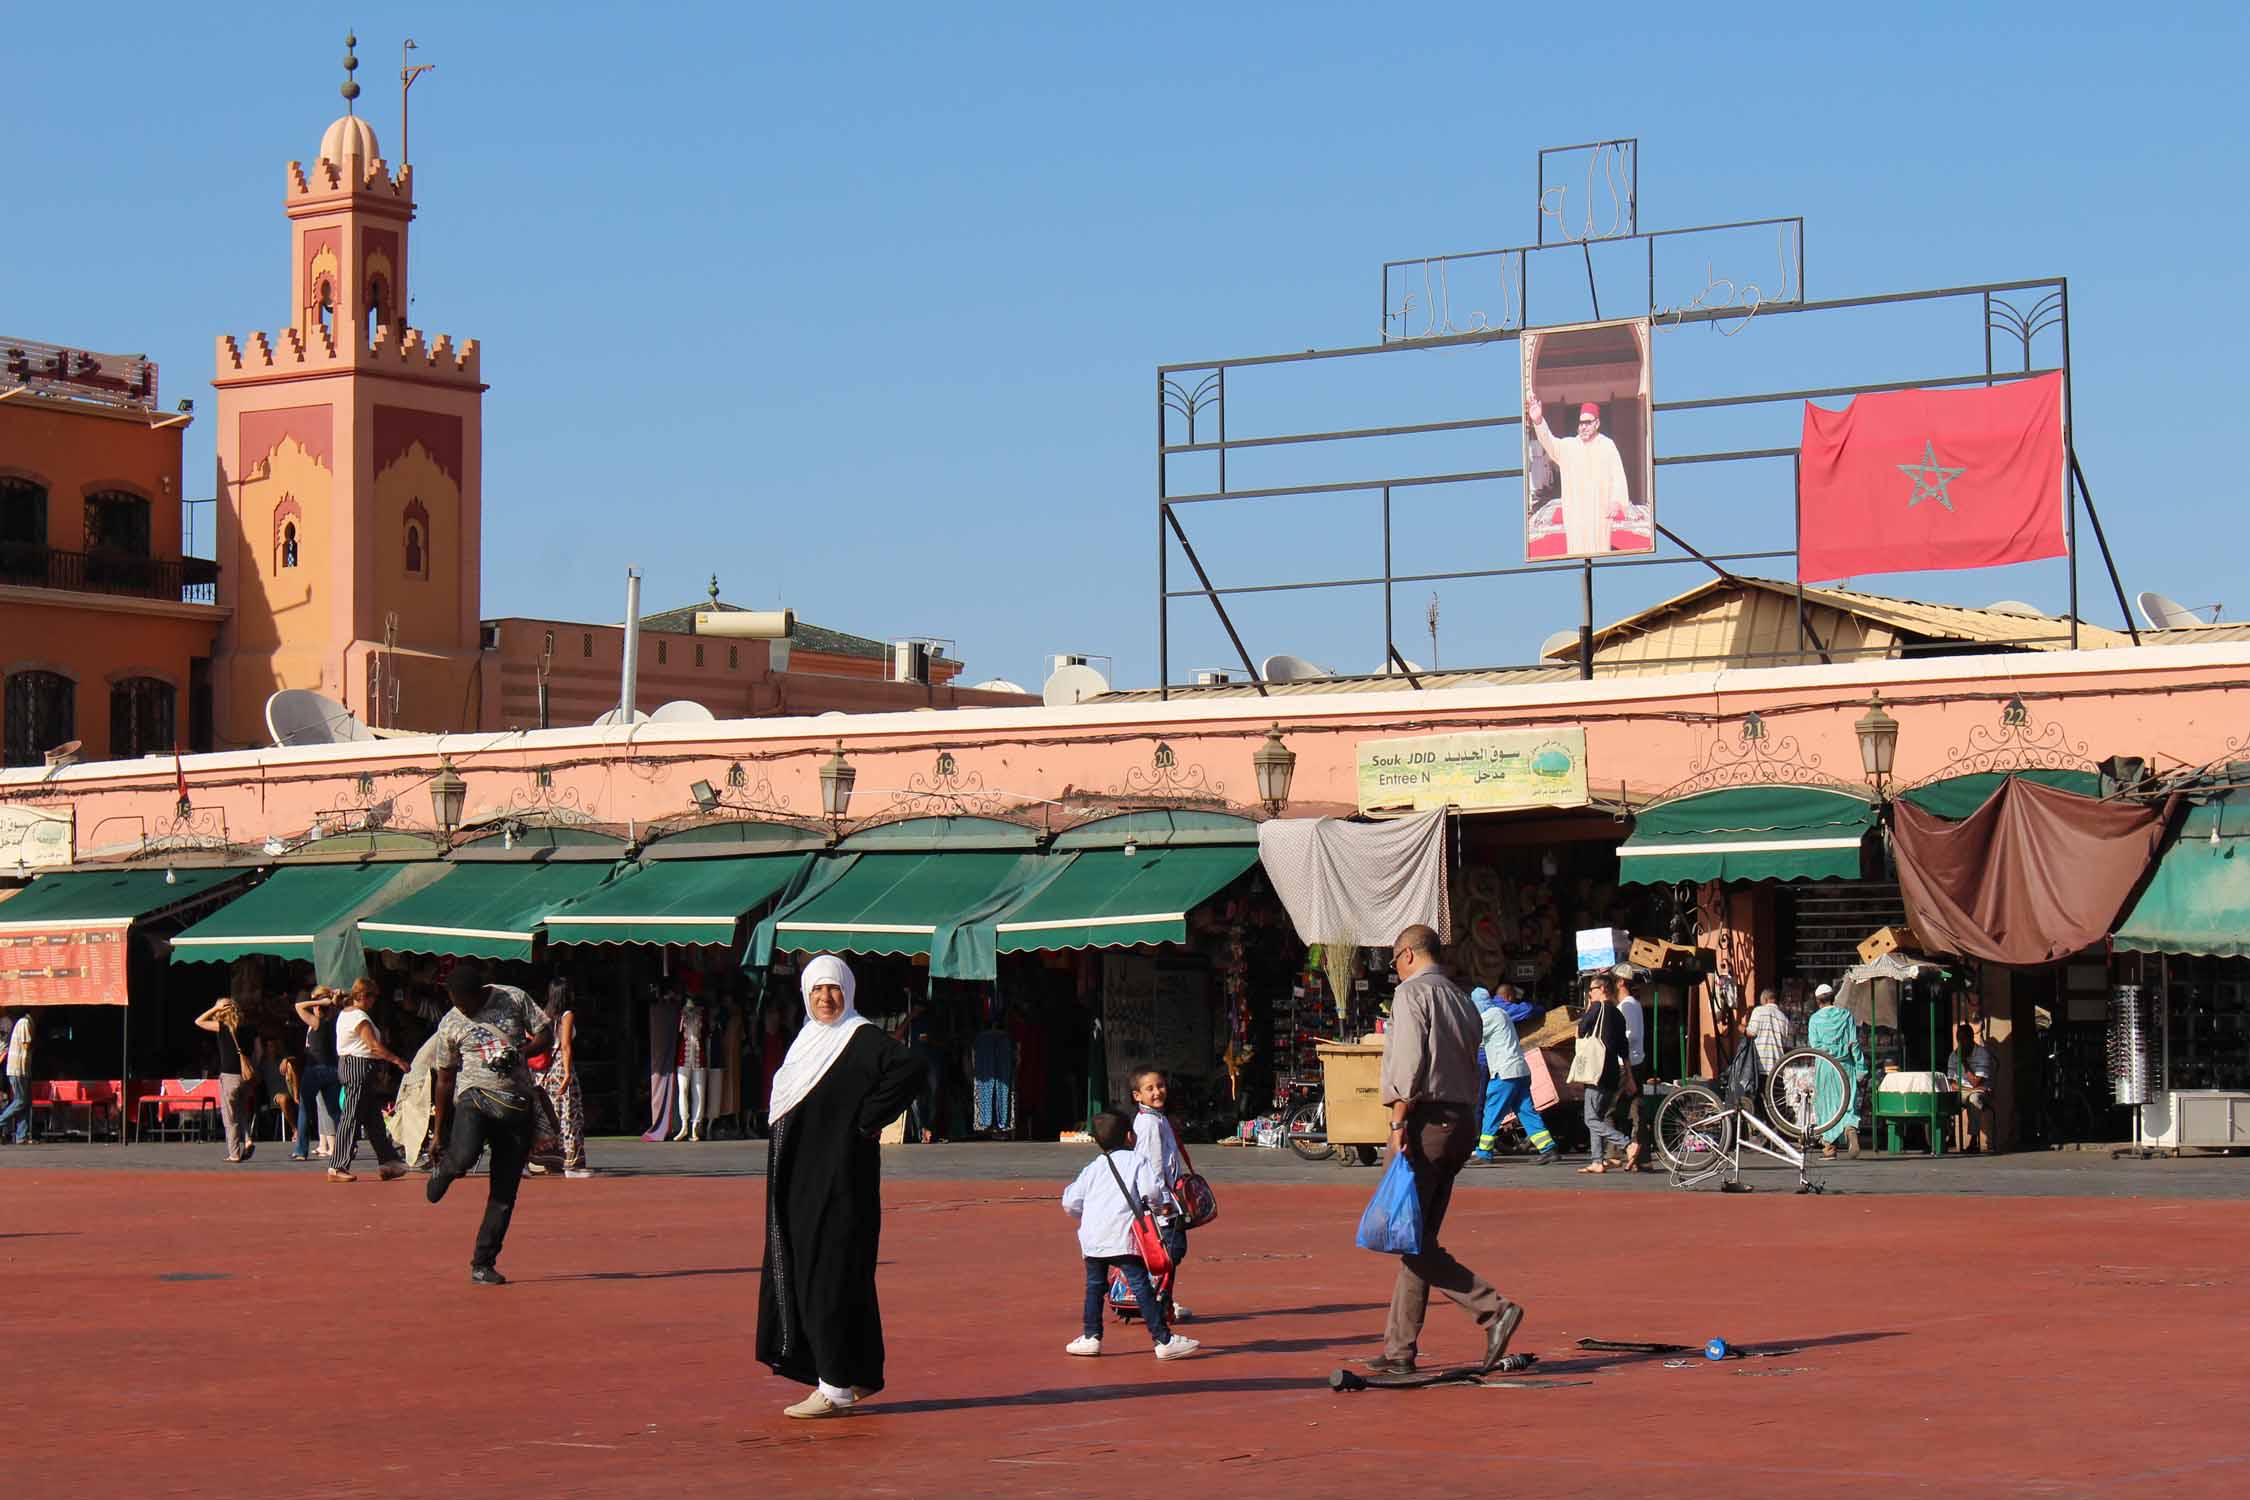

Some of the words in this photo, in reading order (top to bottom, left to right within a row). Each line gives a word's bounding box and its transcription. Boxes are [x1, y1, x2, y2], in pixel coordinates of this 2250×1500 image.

[2005, 707, 2025, 726] 22
[1744, 722, 1763, 740] 21
[938, 759, 953, 774] 19
[1156, 751, 1173, 767] 20
[1372, 753, 1401, 767] Souk
[1407, 751, 1436, 764] JDID
[537, 770, 551, 786] 17
[730, 771, 744, 786] 18
[1474, 769, 1505, 784] مدخل
[359, 779, 372, 793] 16
